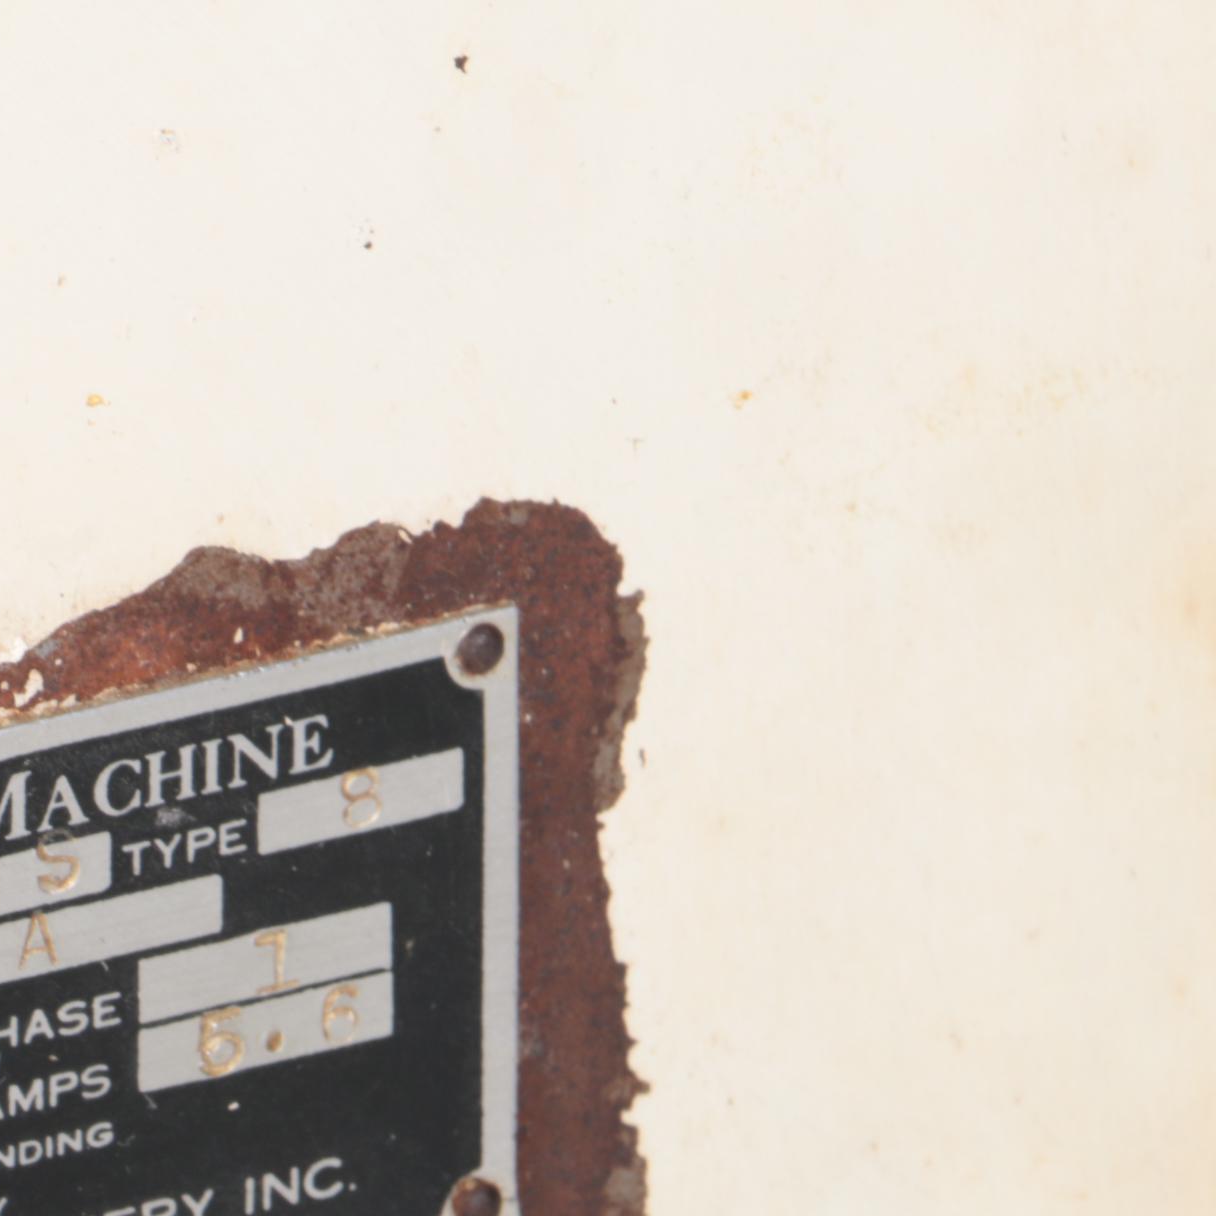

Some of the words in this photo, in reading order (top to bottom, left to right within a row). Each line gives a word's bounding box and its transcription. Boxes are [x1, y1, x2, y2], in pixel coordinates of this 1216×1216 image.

[122, 819, 248, 876] TYPE
[340, 767, 383, 829] 8
[17, 910, 59, 970] A
[243, 1157, 358, 1216] INC.
